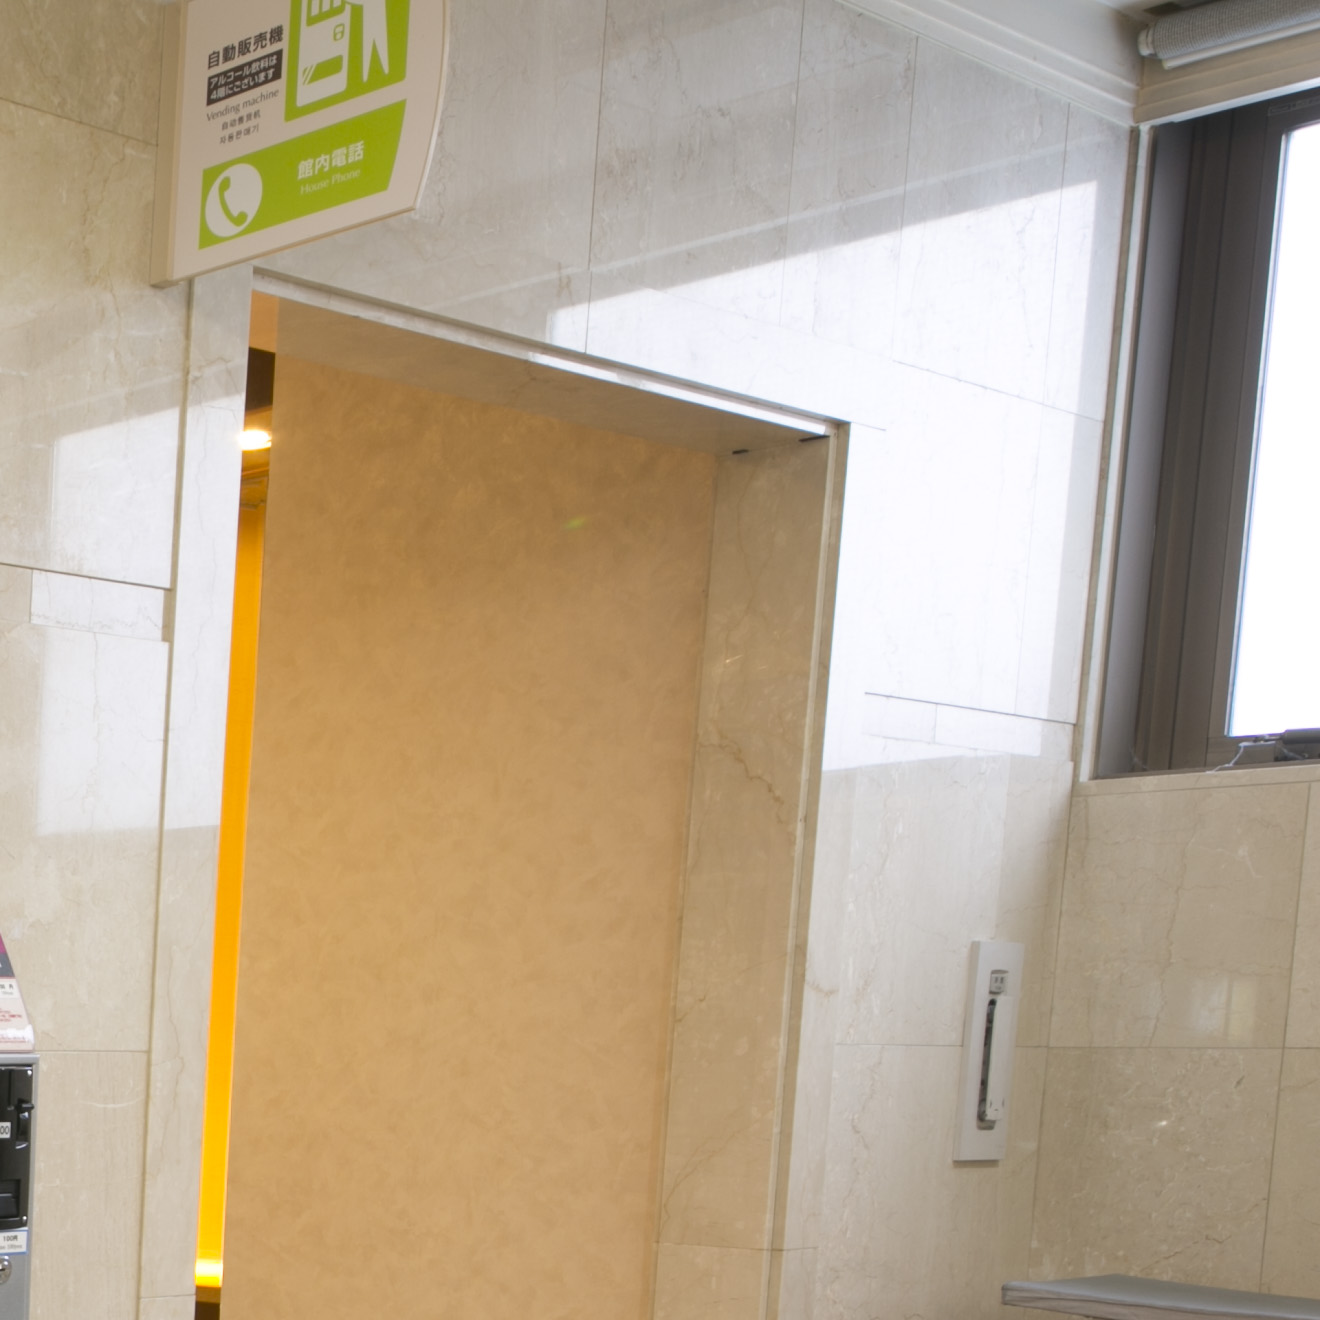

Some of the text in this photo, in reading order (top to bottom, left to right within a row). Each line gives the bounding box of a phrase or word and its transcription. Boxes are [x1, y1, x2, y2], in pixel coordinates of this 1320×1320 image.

[208, 24, 284, 70] 自動販売機
[210, 55, 278, 89] アルコール飲料は
[207, 89, 279, 122] Vending machine
[297, 140, 365, 180] 館内電話
[300, 168, 361, 195] House Phone
